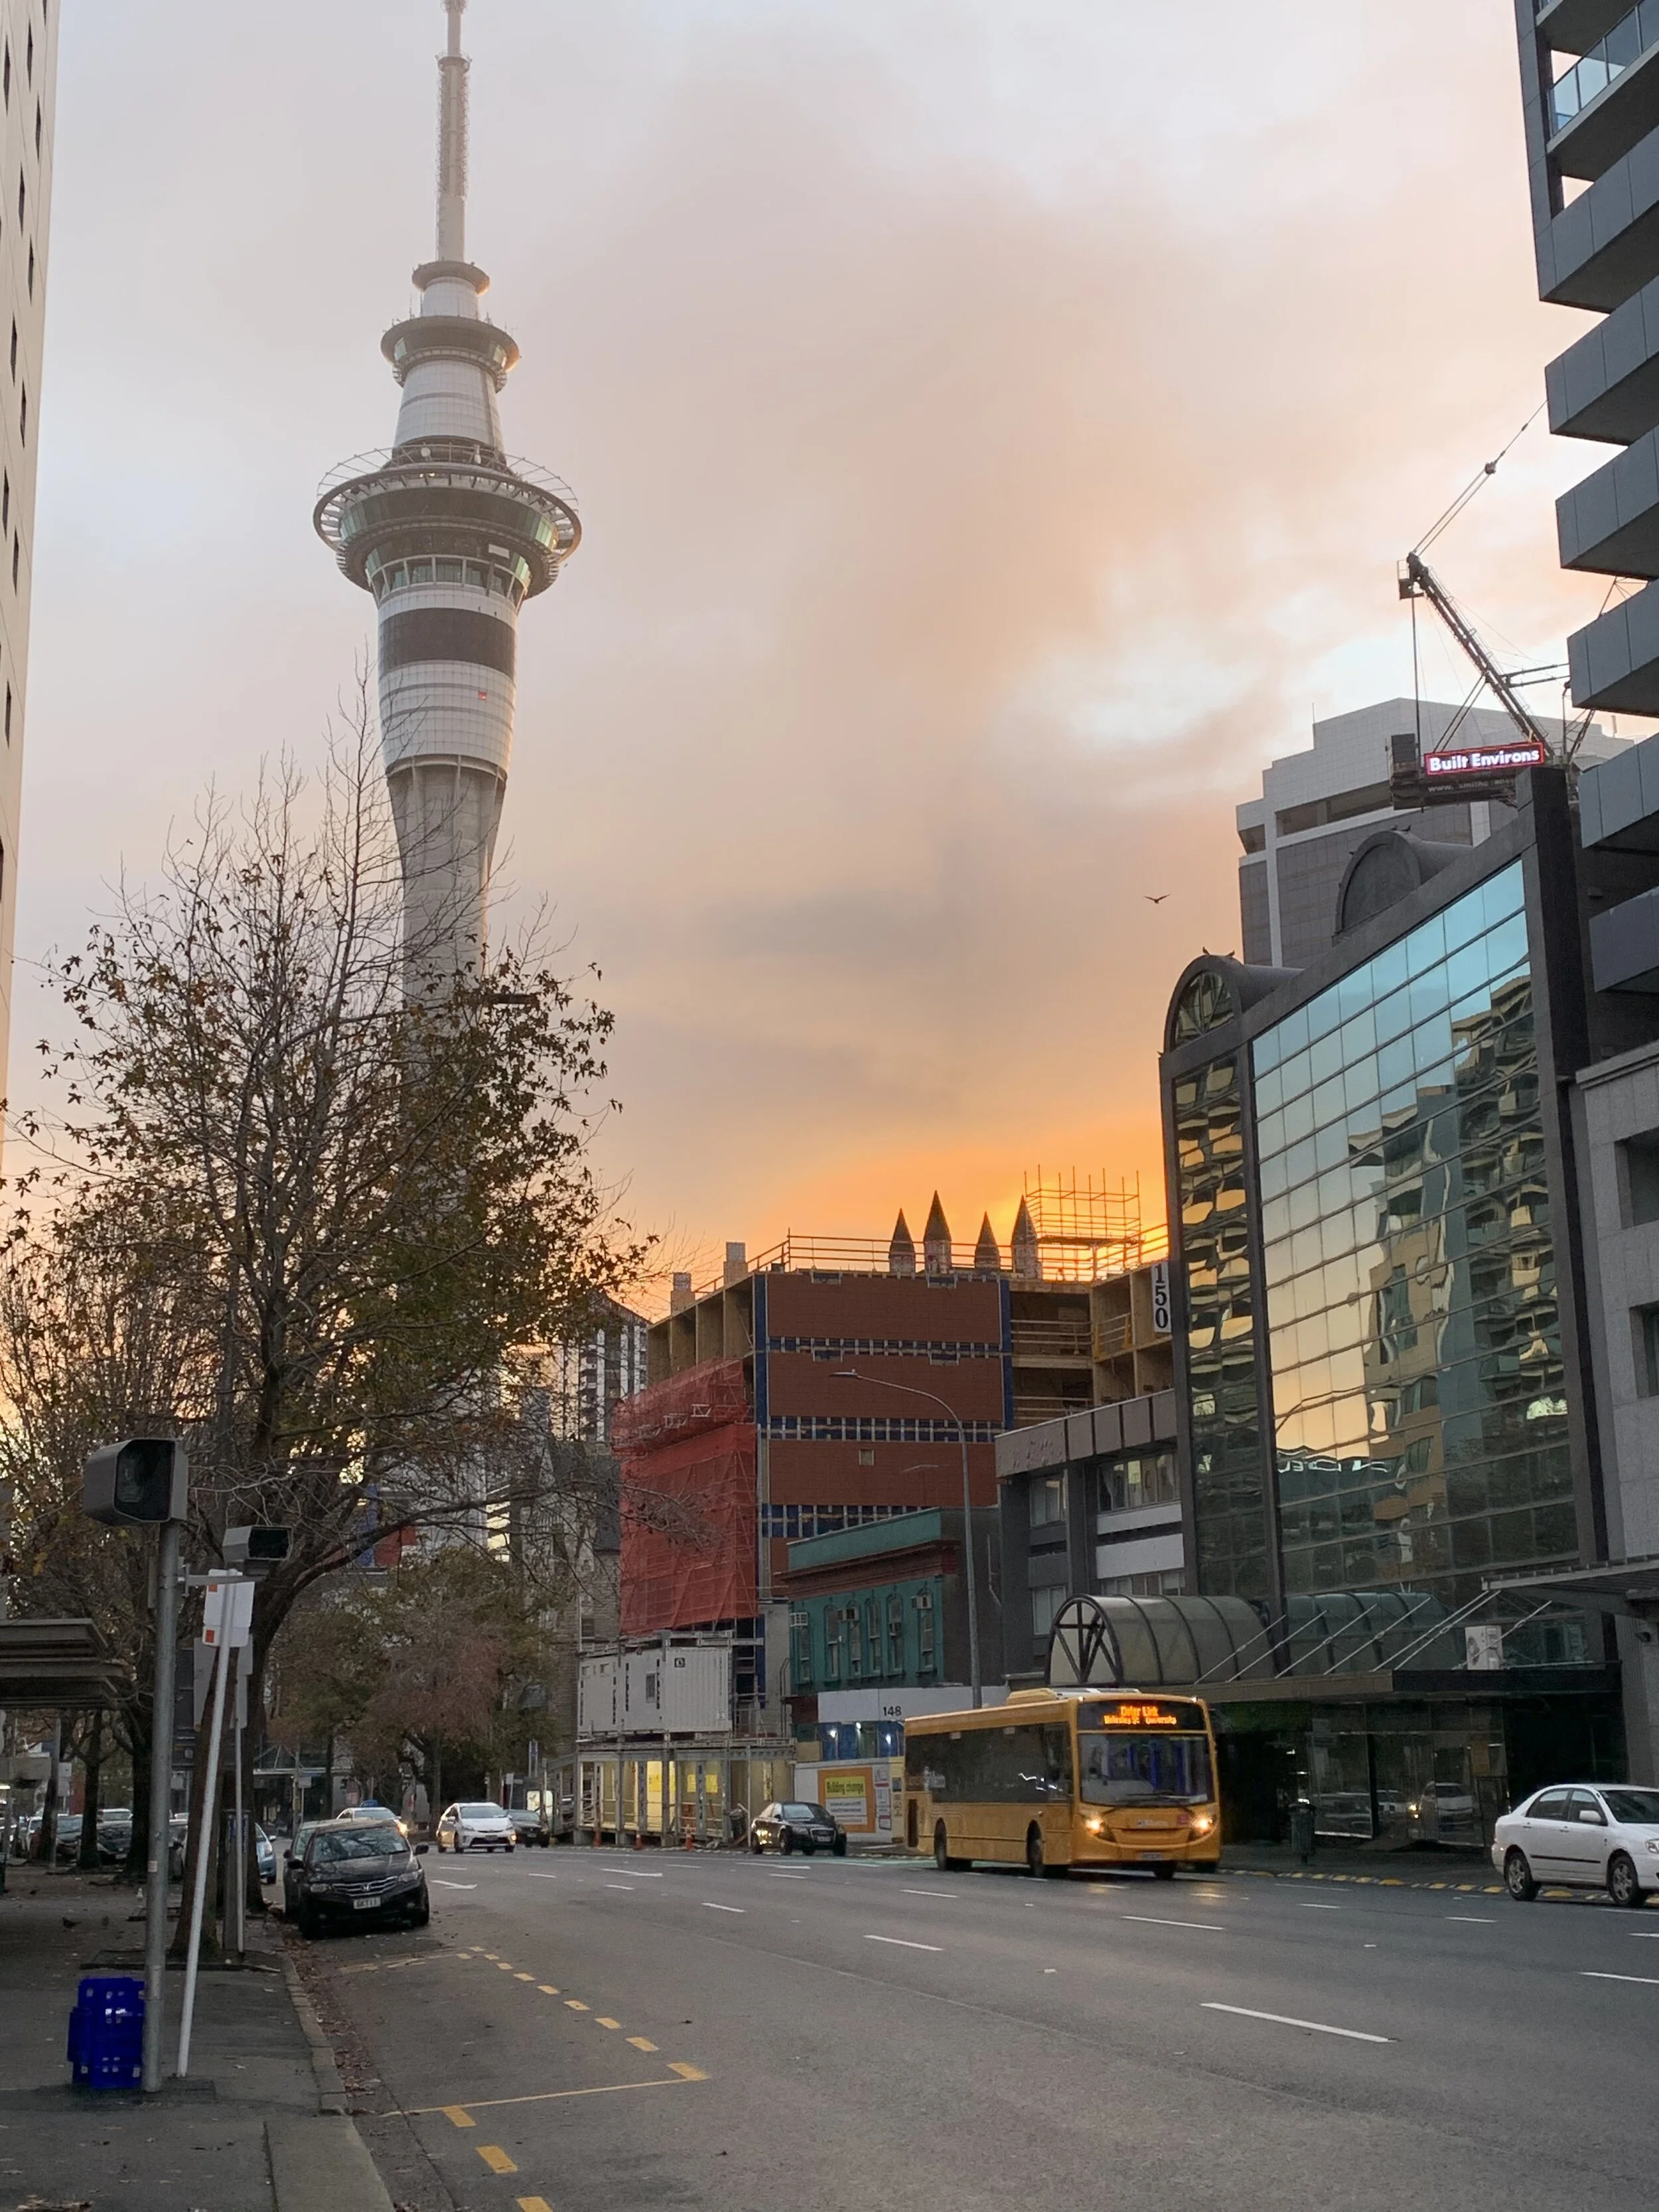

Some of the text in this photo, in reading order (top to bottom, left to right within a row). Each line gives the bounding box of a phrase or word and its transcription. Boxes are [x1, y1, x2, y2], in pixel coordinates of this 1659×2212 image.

[1429, 750, 1540, 772] Built Environs
[1155, 1263, 1169, 1329] 150
[883, 1706, 902, 1717] 148
